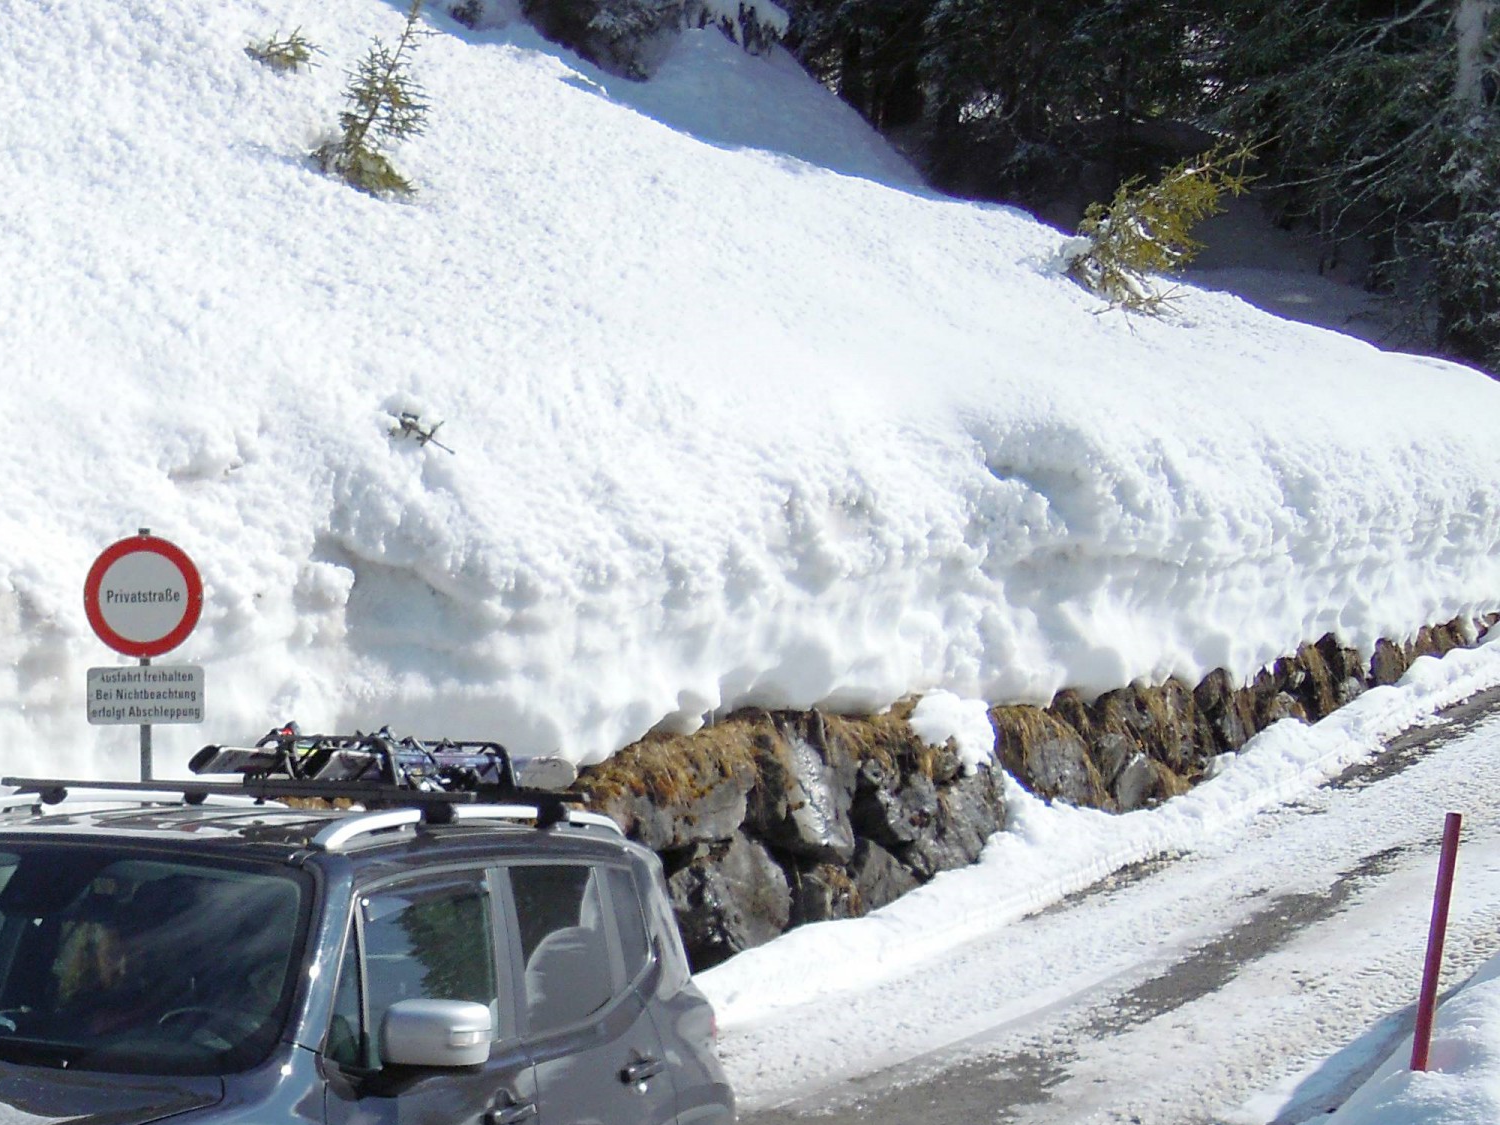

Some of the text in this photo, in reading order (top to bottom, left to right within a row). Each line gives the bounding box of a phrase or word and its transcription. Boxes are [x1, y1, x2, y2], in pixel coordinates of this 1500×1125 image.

[106, 588, 180, 603] Privatstraße
[143, 670, 194, 682] freihalten
[95, 687, 197, 701] Bei Nichtbeachtung
[92, 705, 200, 720] erfolgt Abschleppung
